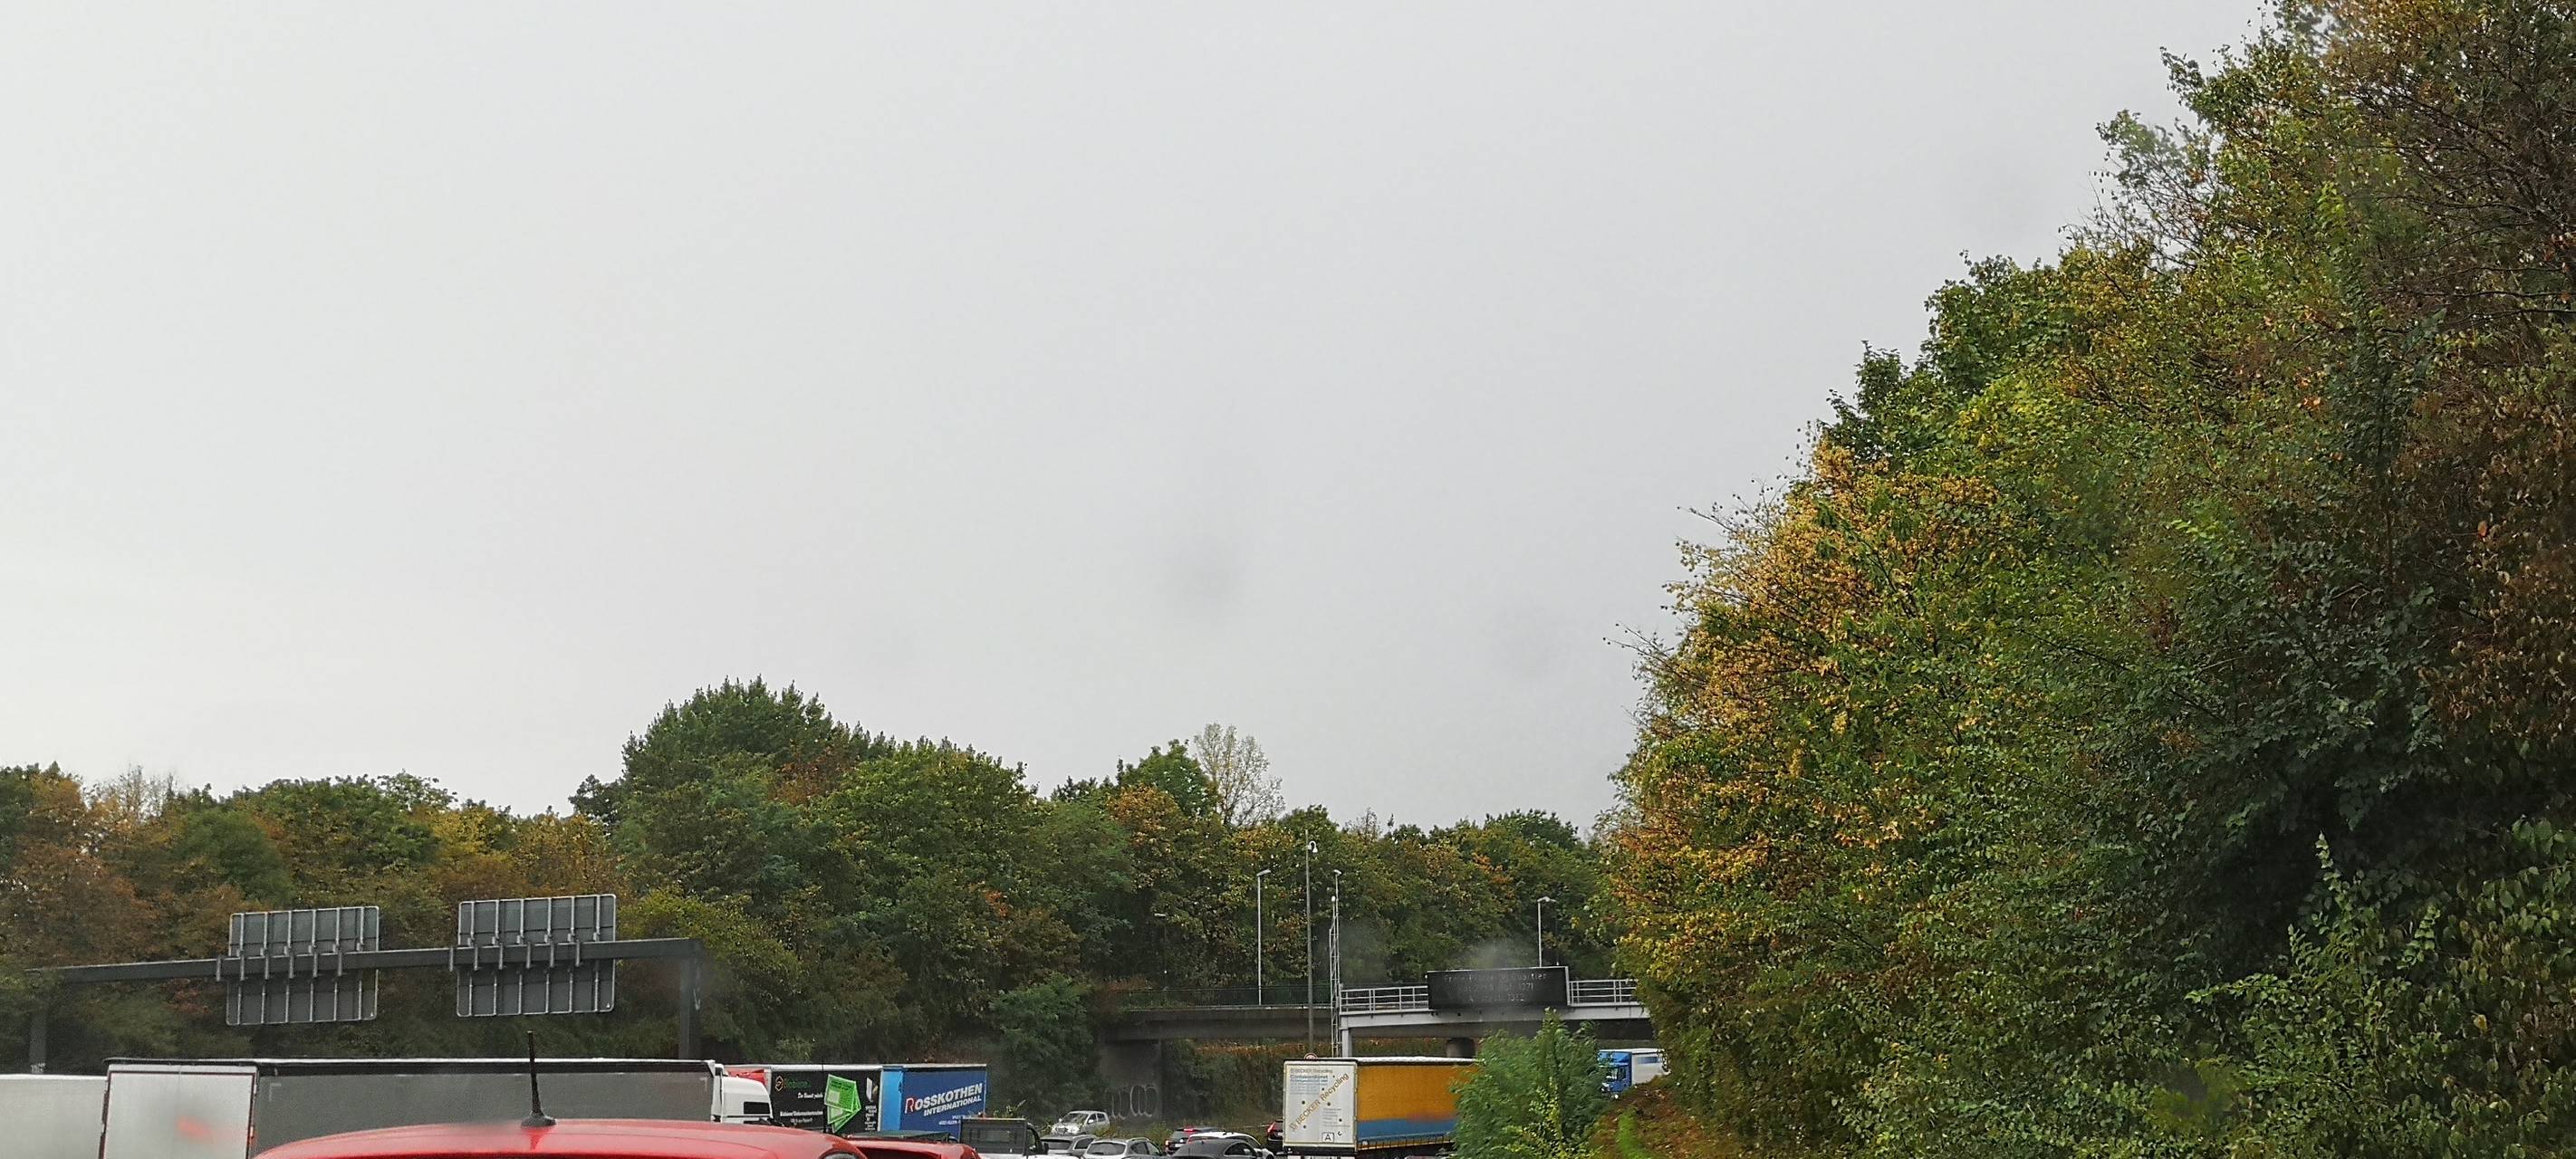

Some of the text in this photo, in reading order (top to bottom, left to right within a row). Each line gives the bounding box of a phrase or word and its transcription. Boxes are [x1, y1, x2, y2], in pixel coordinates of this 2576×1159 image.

[904, 1083, 983, 1114] ROSSKOTHEN
[924, 1095, 982, 1116] INTERNATIONAL
[1296, 1099, 1321, 1125] BECKER
[1320, 1073, 1349, 1101] Recycling
